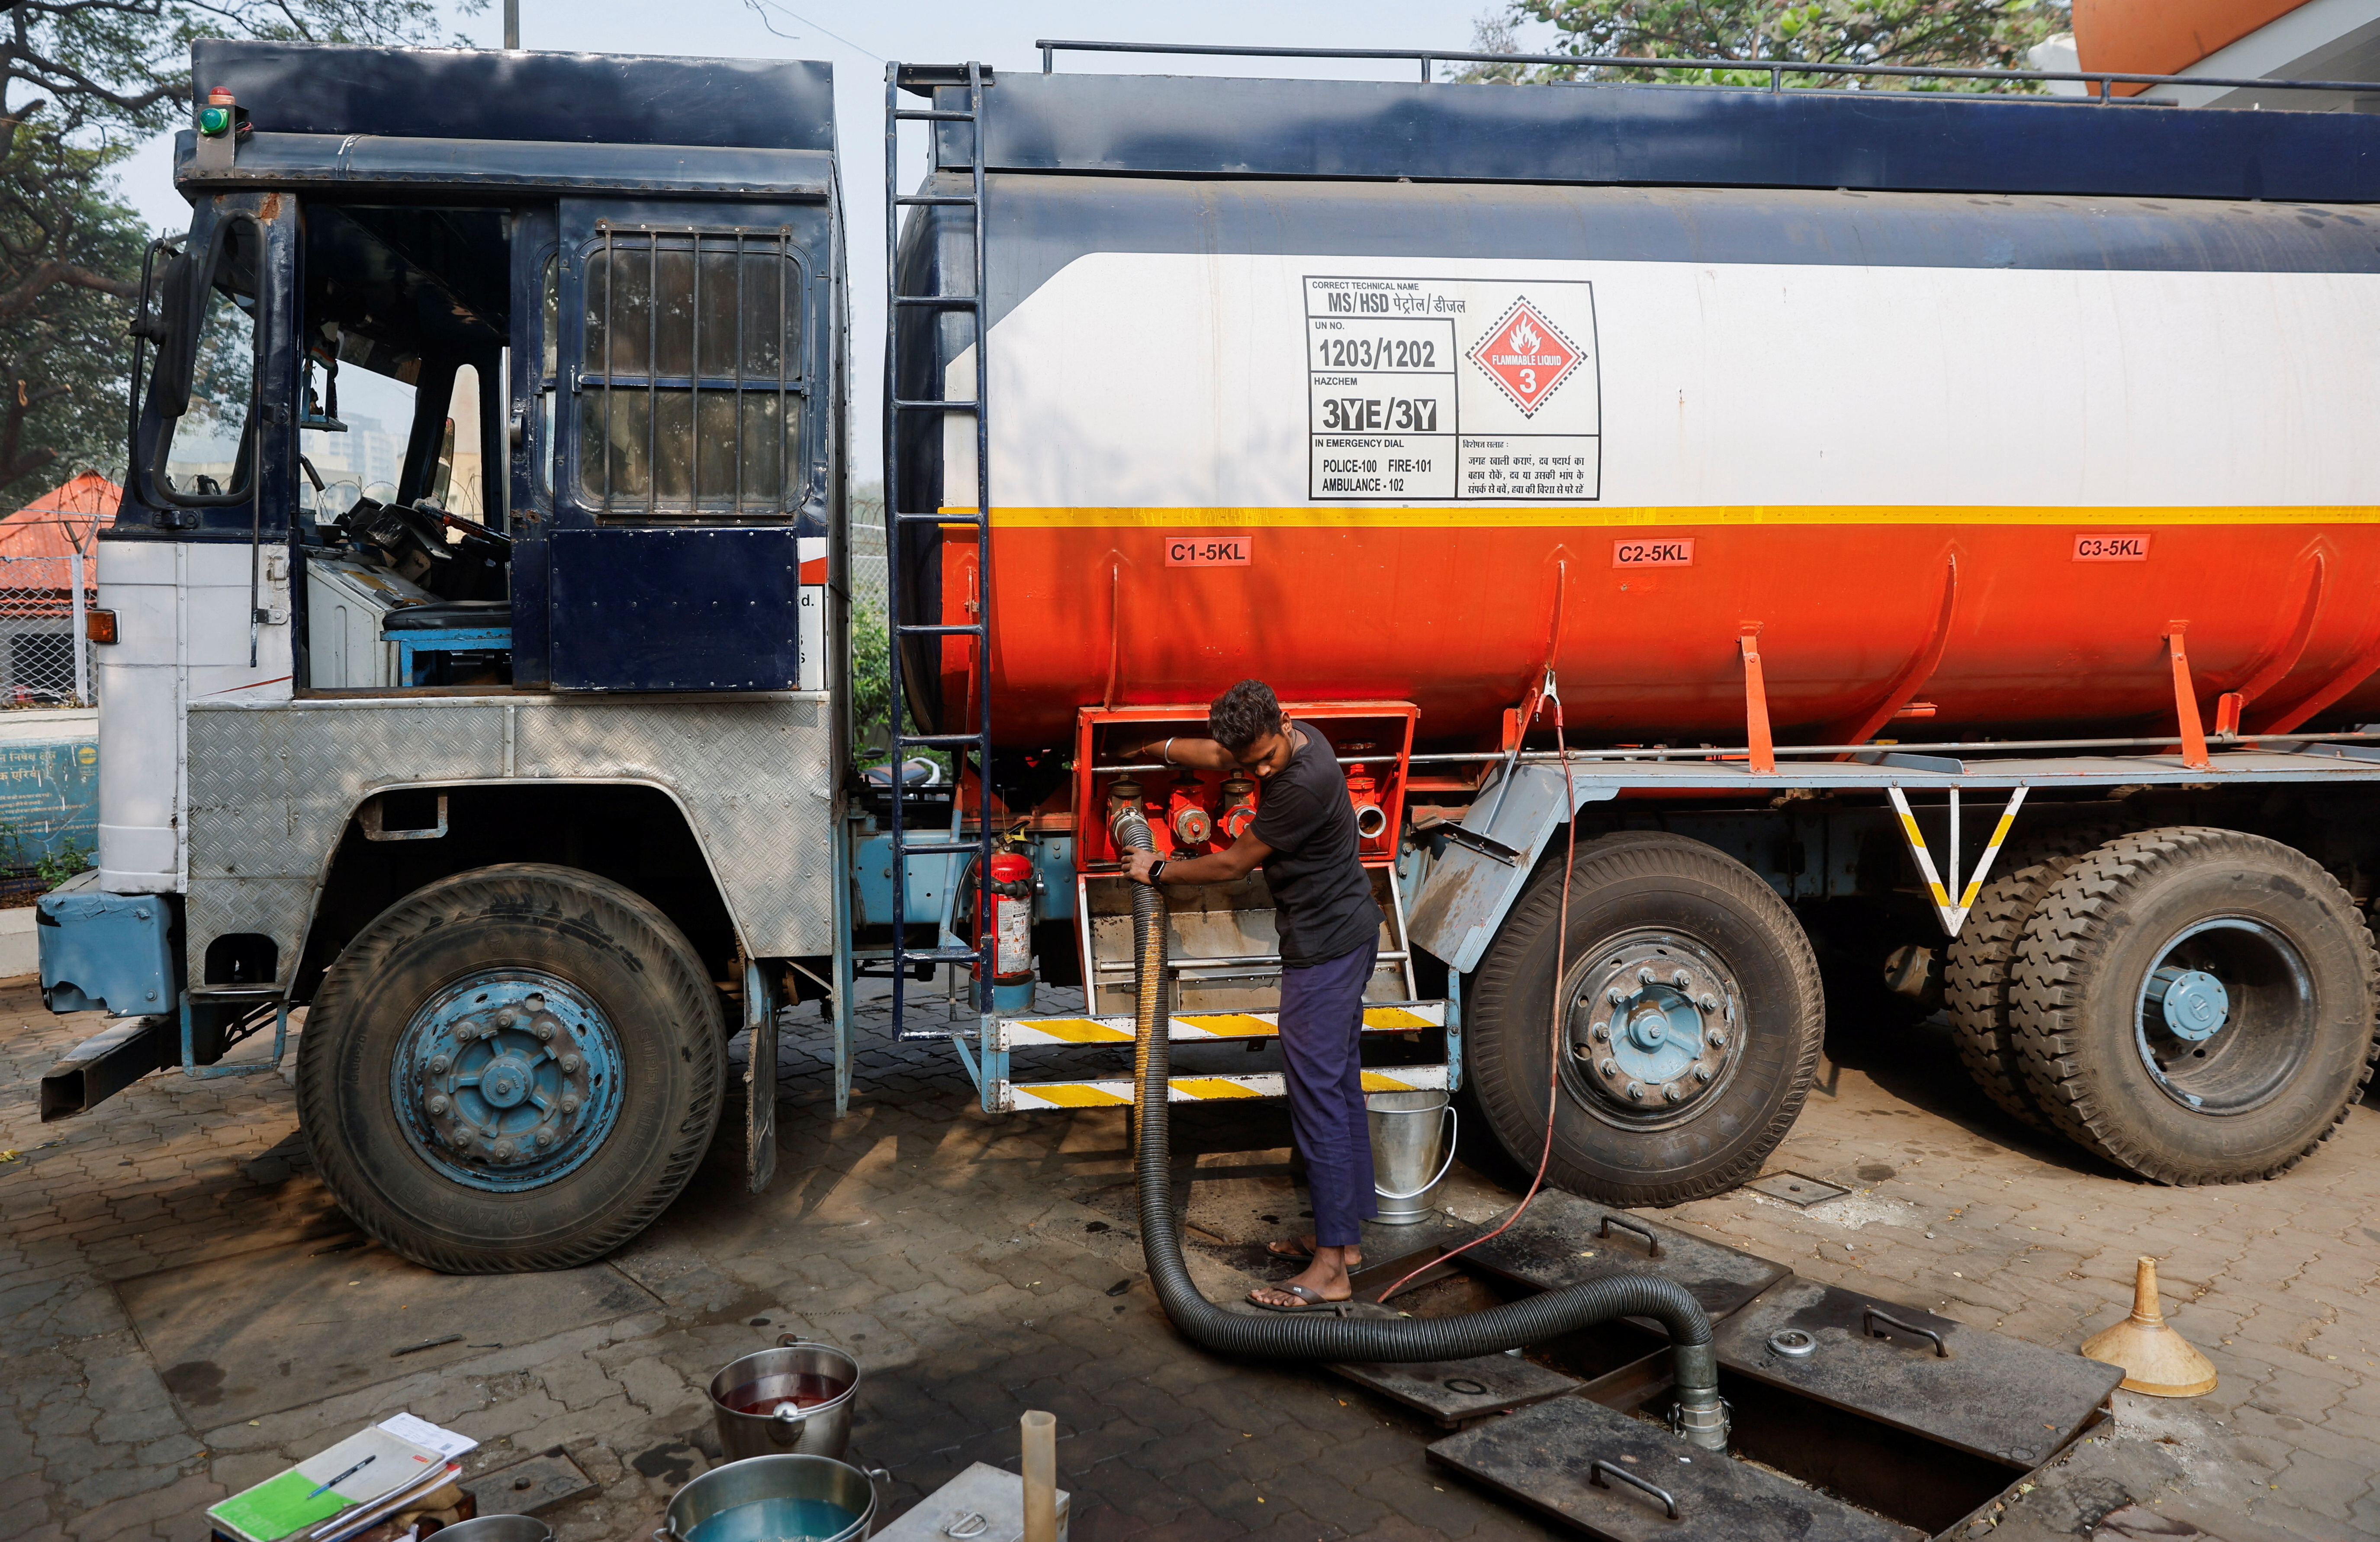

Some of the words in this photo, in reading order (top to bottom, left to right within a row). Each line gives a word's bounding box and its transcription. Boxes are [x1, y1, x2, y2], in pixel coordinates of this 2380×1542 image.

[1312, 281, 1349, 289] CORRECT
[1351, 282, 1395, 290] TECHNICAL
[1328, 292, 1389, 313] MS/HSD
[1330, 322, 1344, 330] NO.
[1320, 338, 1436, 370] 1203/1202
[1492, 354, 1536, 366] FLAMMABLE
[1537, 354, 1561, 366] LIQUID
[1314, 377, 1357, 385] HAZCHEM
[1519, 368, 1537, 393] 3
[1322, 397, 1437, 431] 3YE/3Y
[1315, 439, 1323, 447] IN
[1326, 439, 1382, 447] EMERGENCY
[1384, 439, 1404, 447] DIAL
[1323, 459, 1377, 473] POLICE-100
[1388, 459, 1431, 472] FIRE-101
[1468, 457, 1486, 465] जगह
[1489, 455, 1509, 465] खाली
[1534, 469, 1556, 480] उसकी
[1576, 469, 1584, 480] के
[1322, 478, 1381, 492] AMBULANCE
[1389, 478, 1404, 492] 102
[1488, 483, 1495, 493] से
[1525, 483, 1536, 494] की
[1557, 483, 1563, 494] से
[1565, 483, 1574, 494] परे
[1171, 544, 1245, 560] C1-5KL
[1619, 544, 1688, 562] C2-5KL
[2079, 540, 2143, 556] C3-5KL
[516, 931, 616, 982] MRF
[636, 1028, 659, 1096] SUPER
[619, 1100, 656, 1162] MILER
[398, 1184, 499, 1231] MRF
